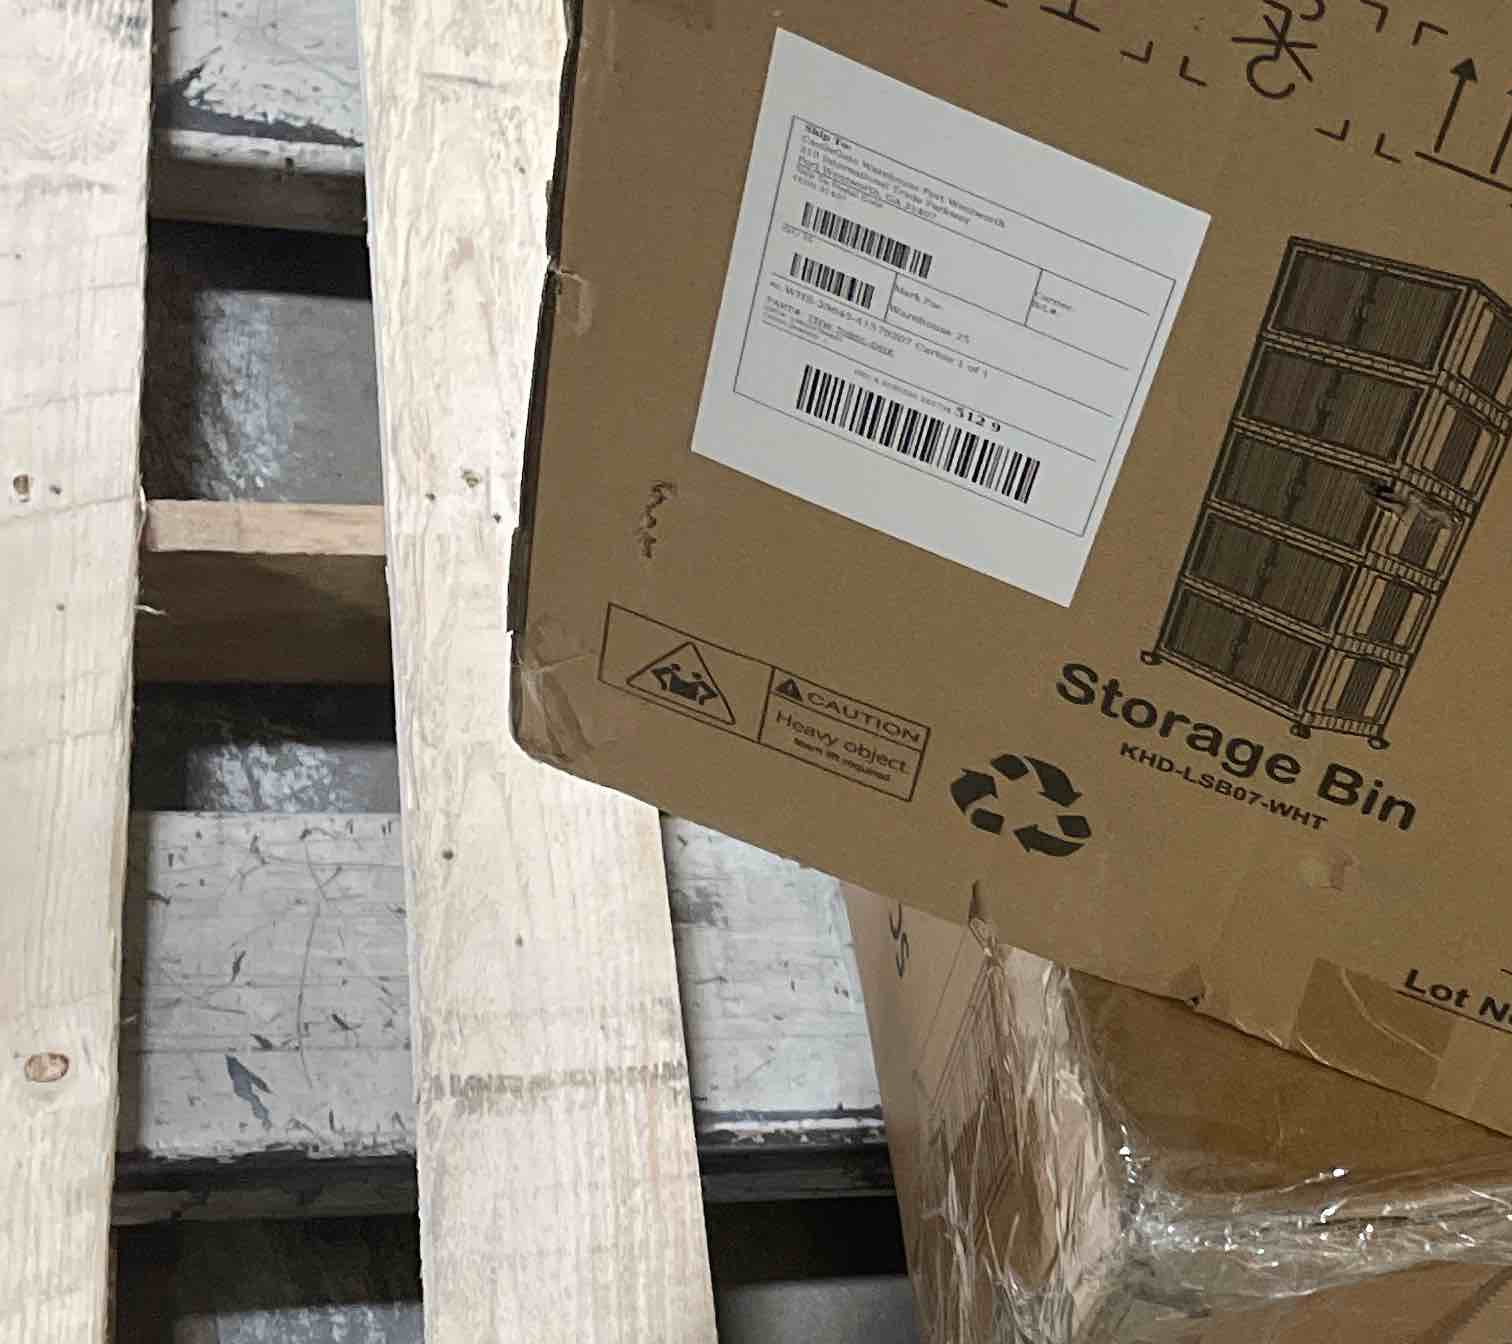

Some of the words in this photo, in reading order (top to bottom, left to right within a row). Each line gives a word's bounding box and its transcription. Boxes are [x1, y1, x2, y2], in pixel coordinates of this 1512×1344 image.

[776, 710, 839, 746] Heavy
[843, 740, 911, 775] object
[808, 692, 920, 743] CAUTION
[1055, 662, 1301, 784] Storage
[1316, 761, 1417, 831] Bin
[1119, 741, 1329, 831] KHD-LSB07-WHT
[1404, 968, 1472, 1010] Lot
